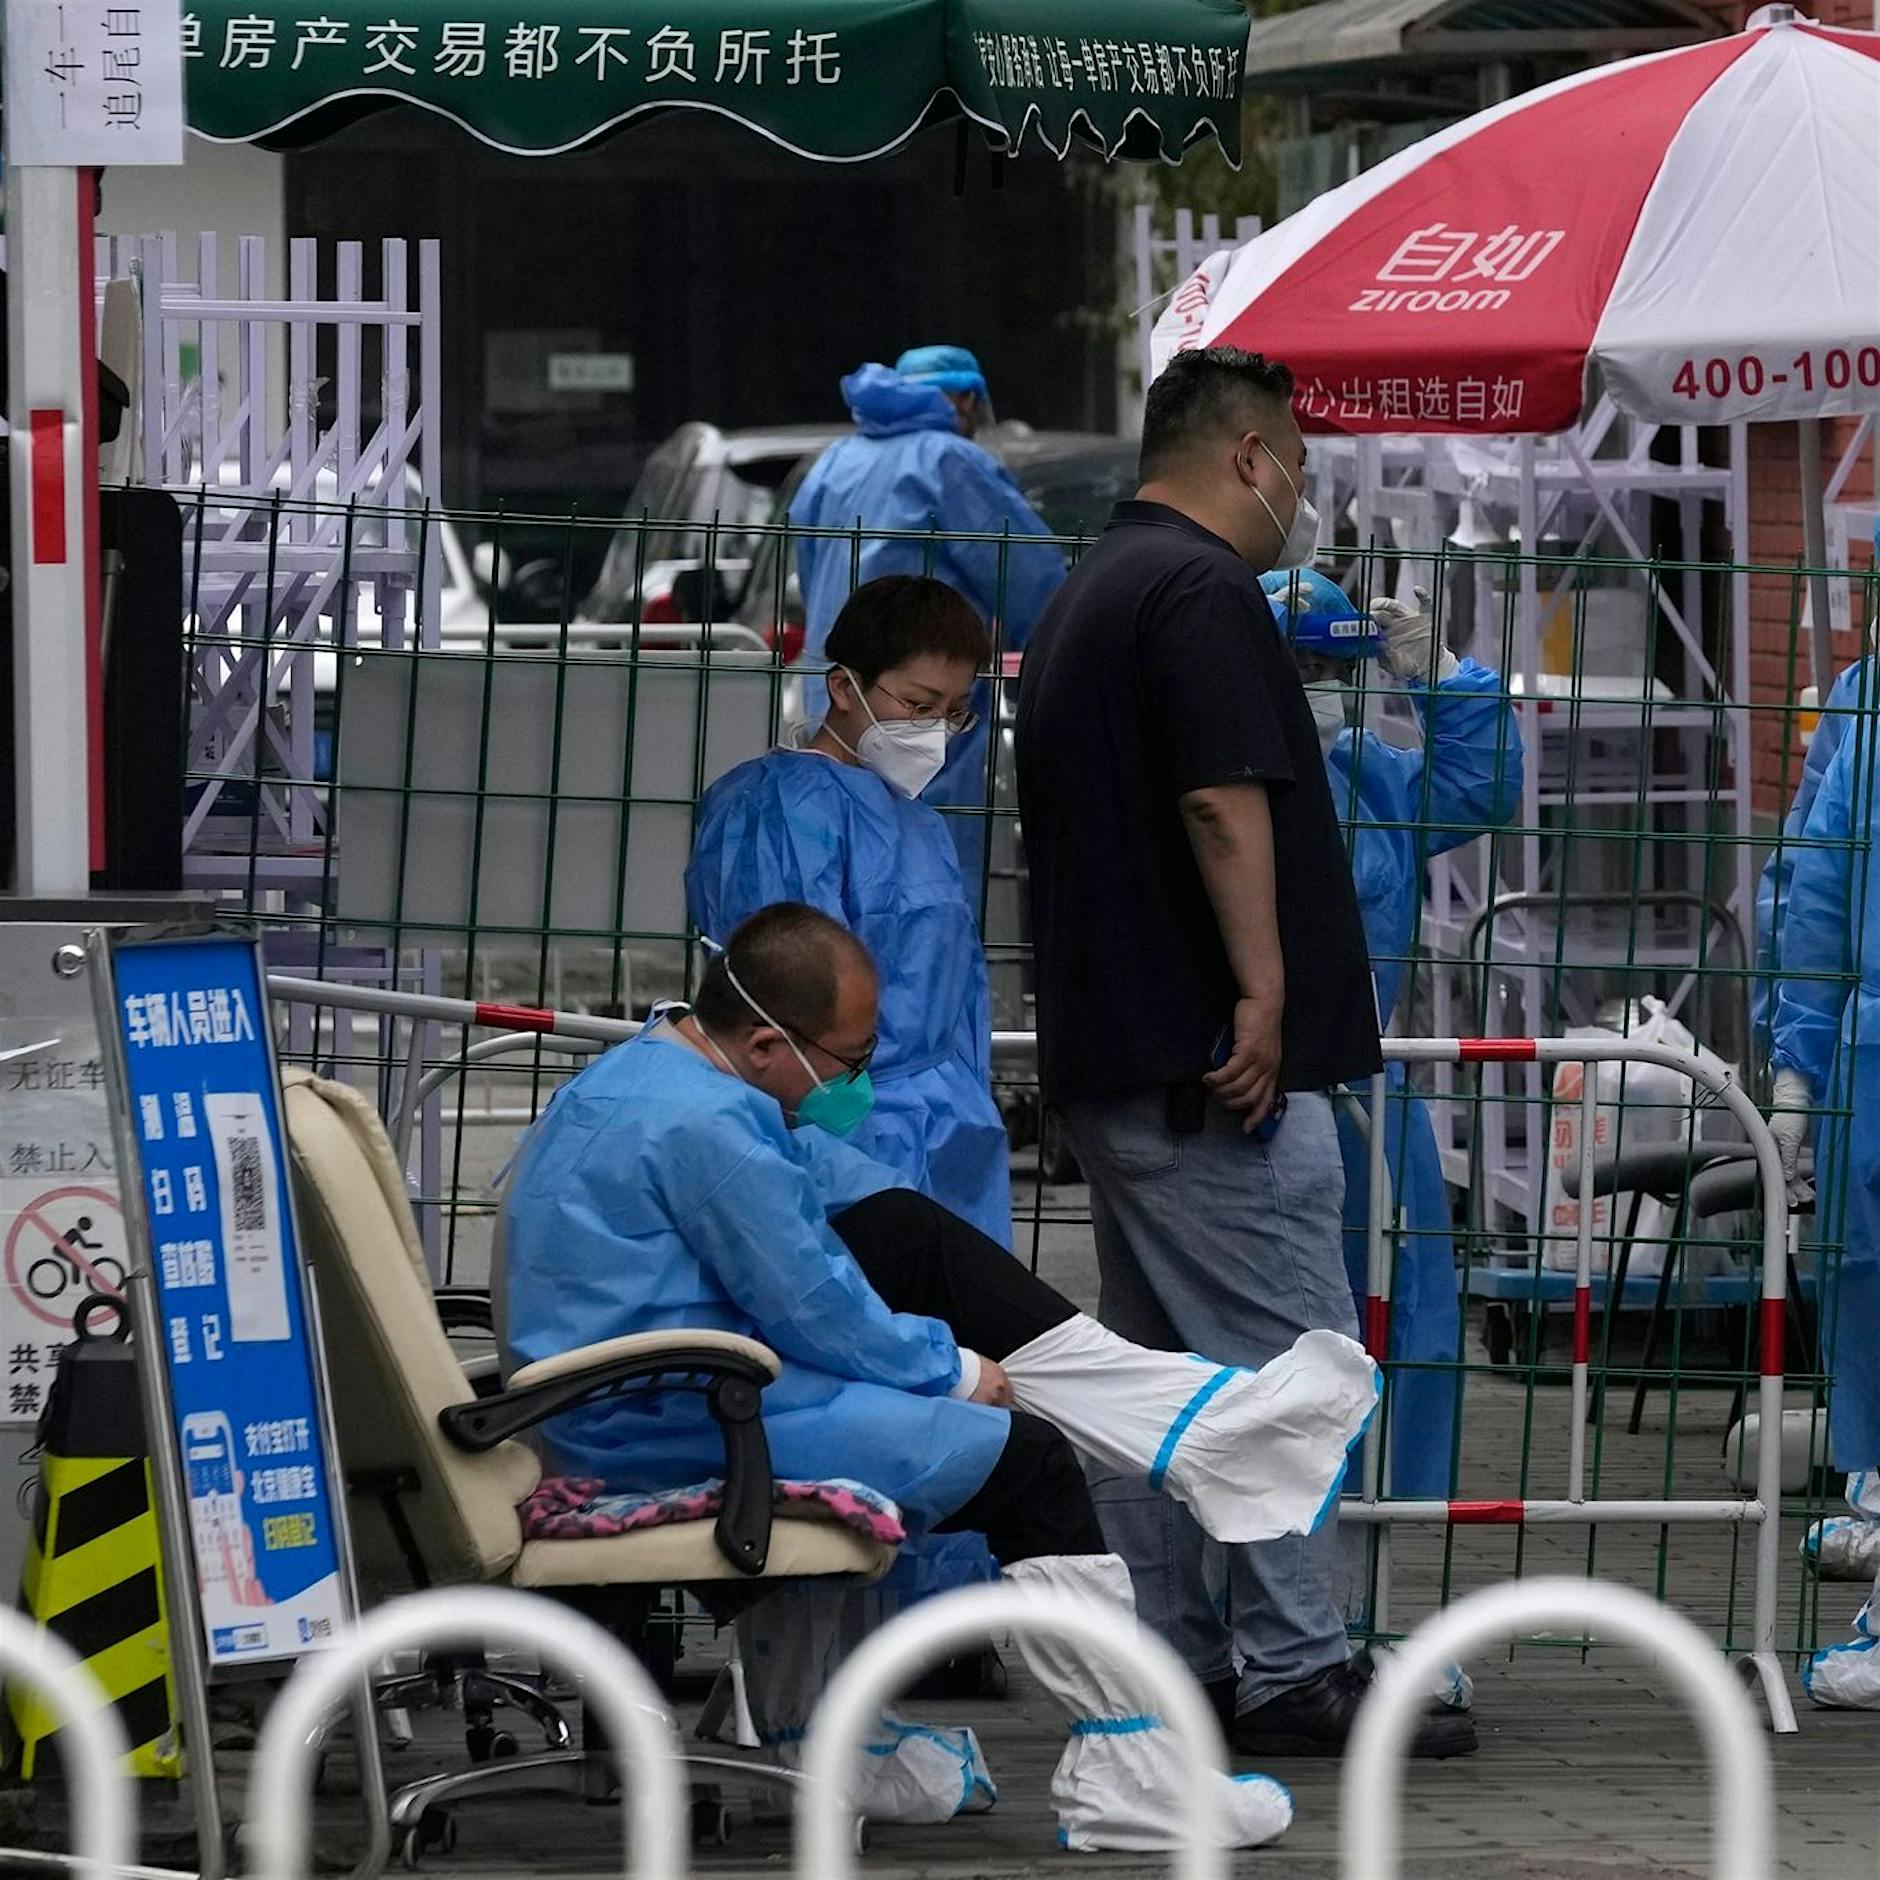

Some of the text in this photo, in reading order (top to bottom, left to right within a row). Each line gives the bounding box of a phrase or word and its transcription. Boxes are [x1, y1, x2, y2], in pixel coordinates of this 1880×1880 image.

[101, 9, 142, 130] 追尾自
[1376, 222, 1566, 282] 自如
[1348, 289, 1512, 313] ziroom
[1671, 346, 1880, 400] 400-100
[1299, 375, 1525, 422] 心出租选自如
[124, 987, 255, 1049] 车辆人员进入
[10, 1142, 111, 1174] 禁止入
[151, 1166, 207, 1215] 扫码
[170, 1313, 225, 1364] 登记
[244, 1417, 311, 1457] 支付宝打开
[251, 1464, 319, 1504] 北京健康宝
